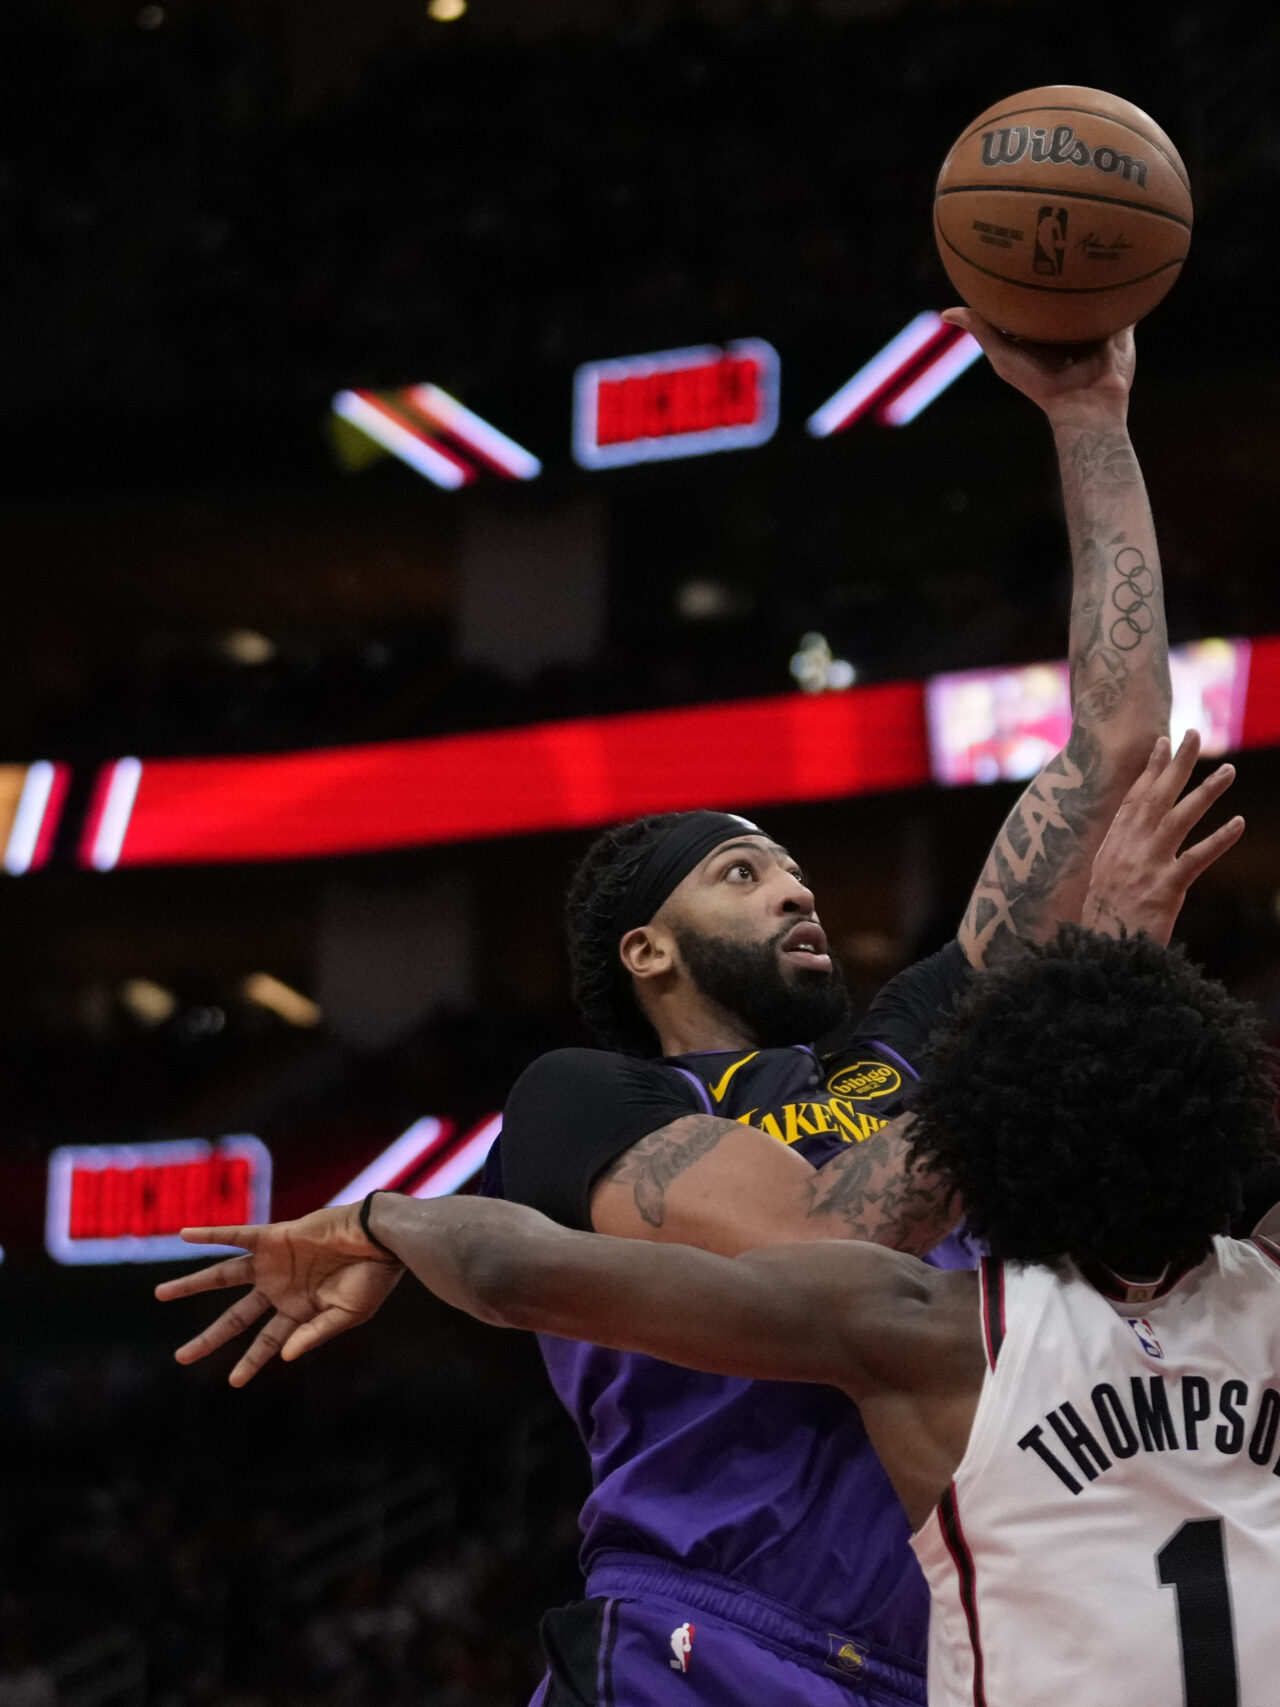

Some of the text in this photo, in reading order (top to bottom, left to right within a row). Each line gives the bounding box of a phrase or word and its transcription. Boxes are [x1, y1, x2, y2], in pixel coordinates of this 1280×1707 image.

[981, 125, 1148, 190] Wilson
[834, 1066, 894, 1094] bibigo
[1153, 1515, 1241, 1707] 1
